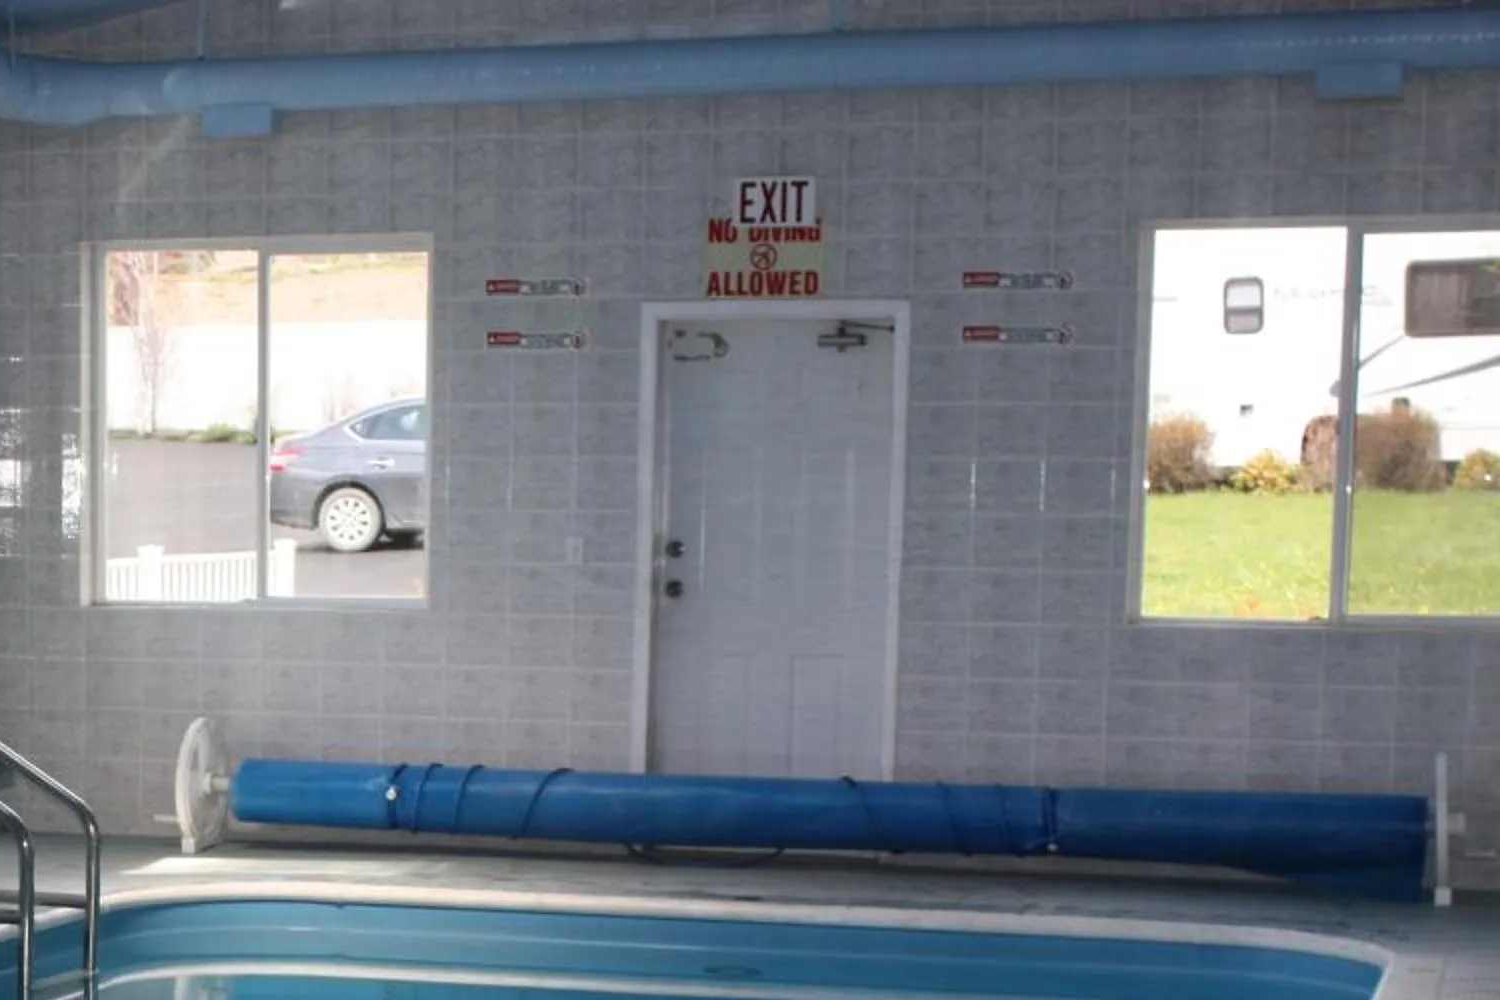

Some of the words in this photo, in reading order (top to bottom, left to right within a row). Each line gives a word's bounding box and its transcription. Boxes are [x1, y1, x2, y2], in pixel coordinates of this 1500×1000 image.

[740, 180, 809, 224] EXIT
[708, 218, 738, 243] NO
[707, 271, 819, 297] ALLOWED
